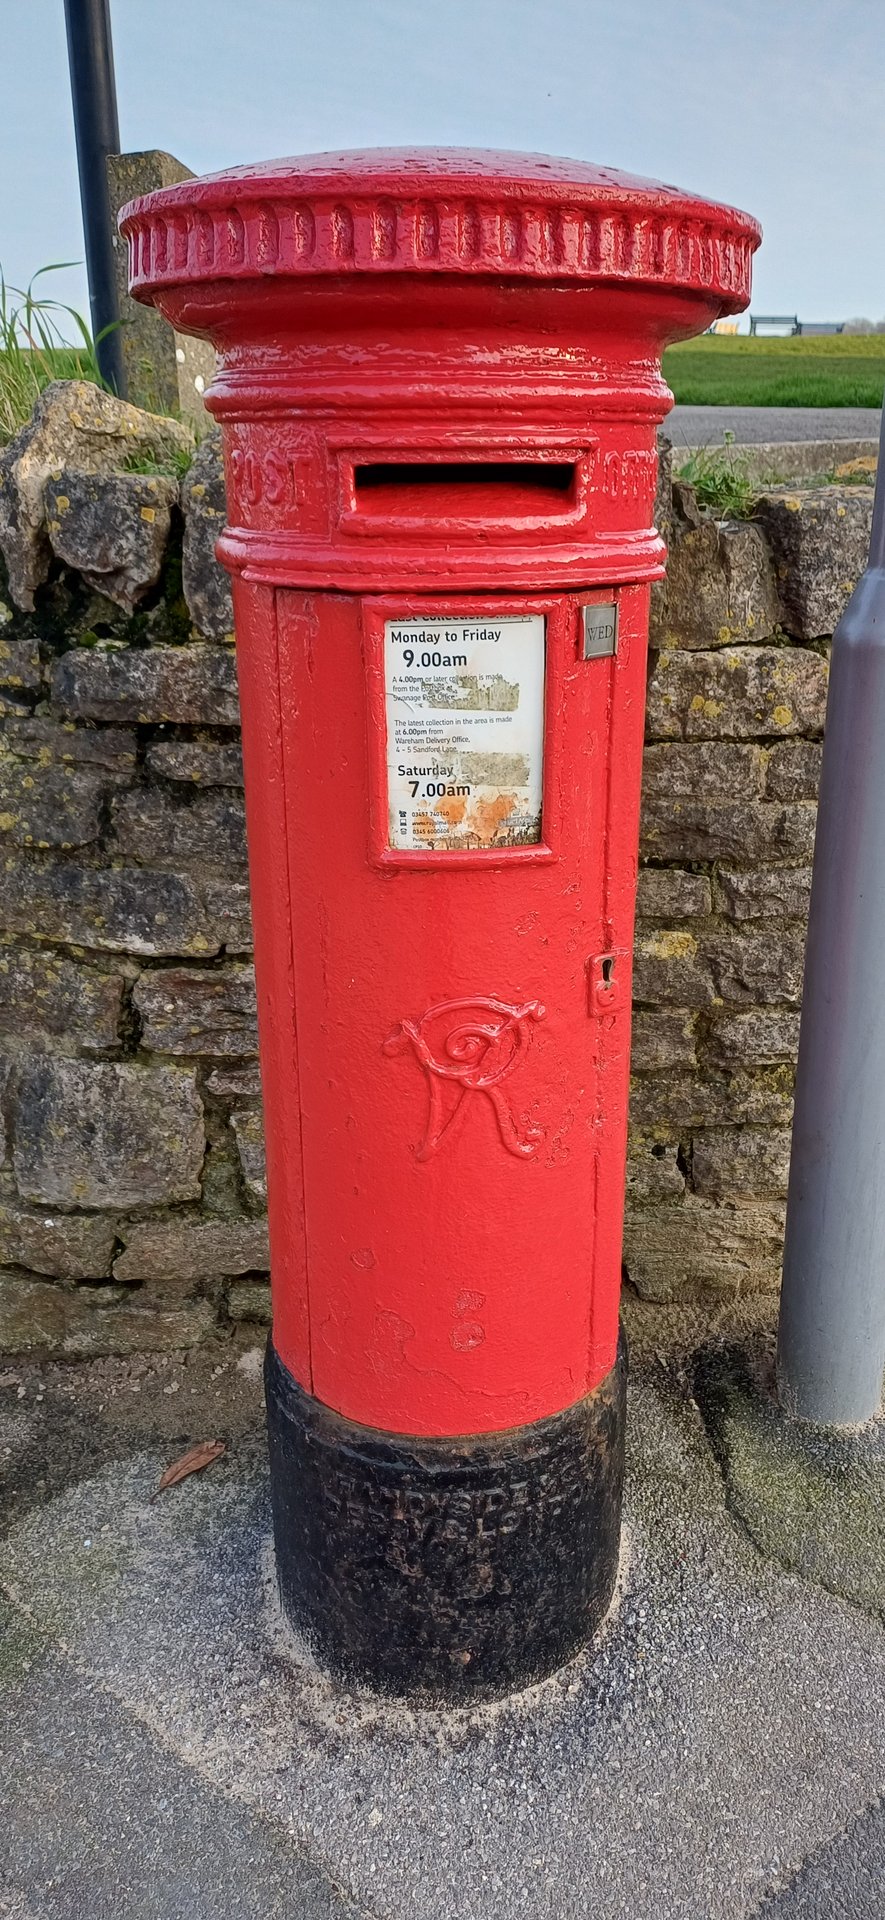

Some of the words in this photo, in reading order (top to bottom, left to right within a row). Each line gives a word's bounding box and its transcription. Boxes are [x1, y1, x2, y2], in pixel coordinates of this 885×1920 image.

[230, 447, 313, 506] POST
[391, 631, 440, 645] Monday
[445, 631, 458, 642] to
[463, 629, 501, 642] Friday
[587, 624, 614, 641] WED
[402, 649, 467, 668] 9.00am
[399, 675, 424, 685] 4.00pm
[433, 675, 448, 683] later
[392, 695, 421, 703] Swanage
[394, 719, 407, 727] The
[426, 718, 454, 726] collection
[463, 717, 473, 725] the
[495, 715, 513, 723] made
[402, 728, 428, 736] 6.00pm
[428, 727, 444, 735] from
[394, 736, 425, 744] Wareham
[425, 735, 451, 744] Delivery
[412, 745, 441, 753] Sandford
[397, 763, 454, 778] Saturday
[408, 780, 471, 798] 7.00am
